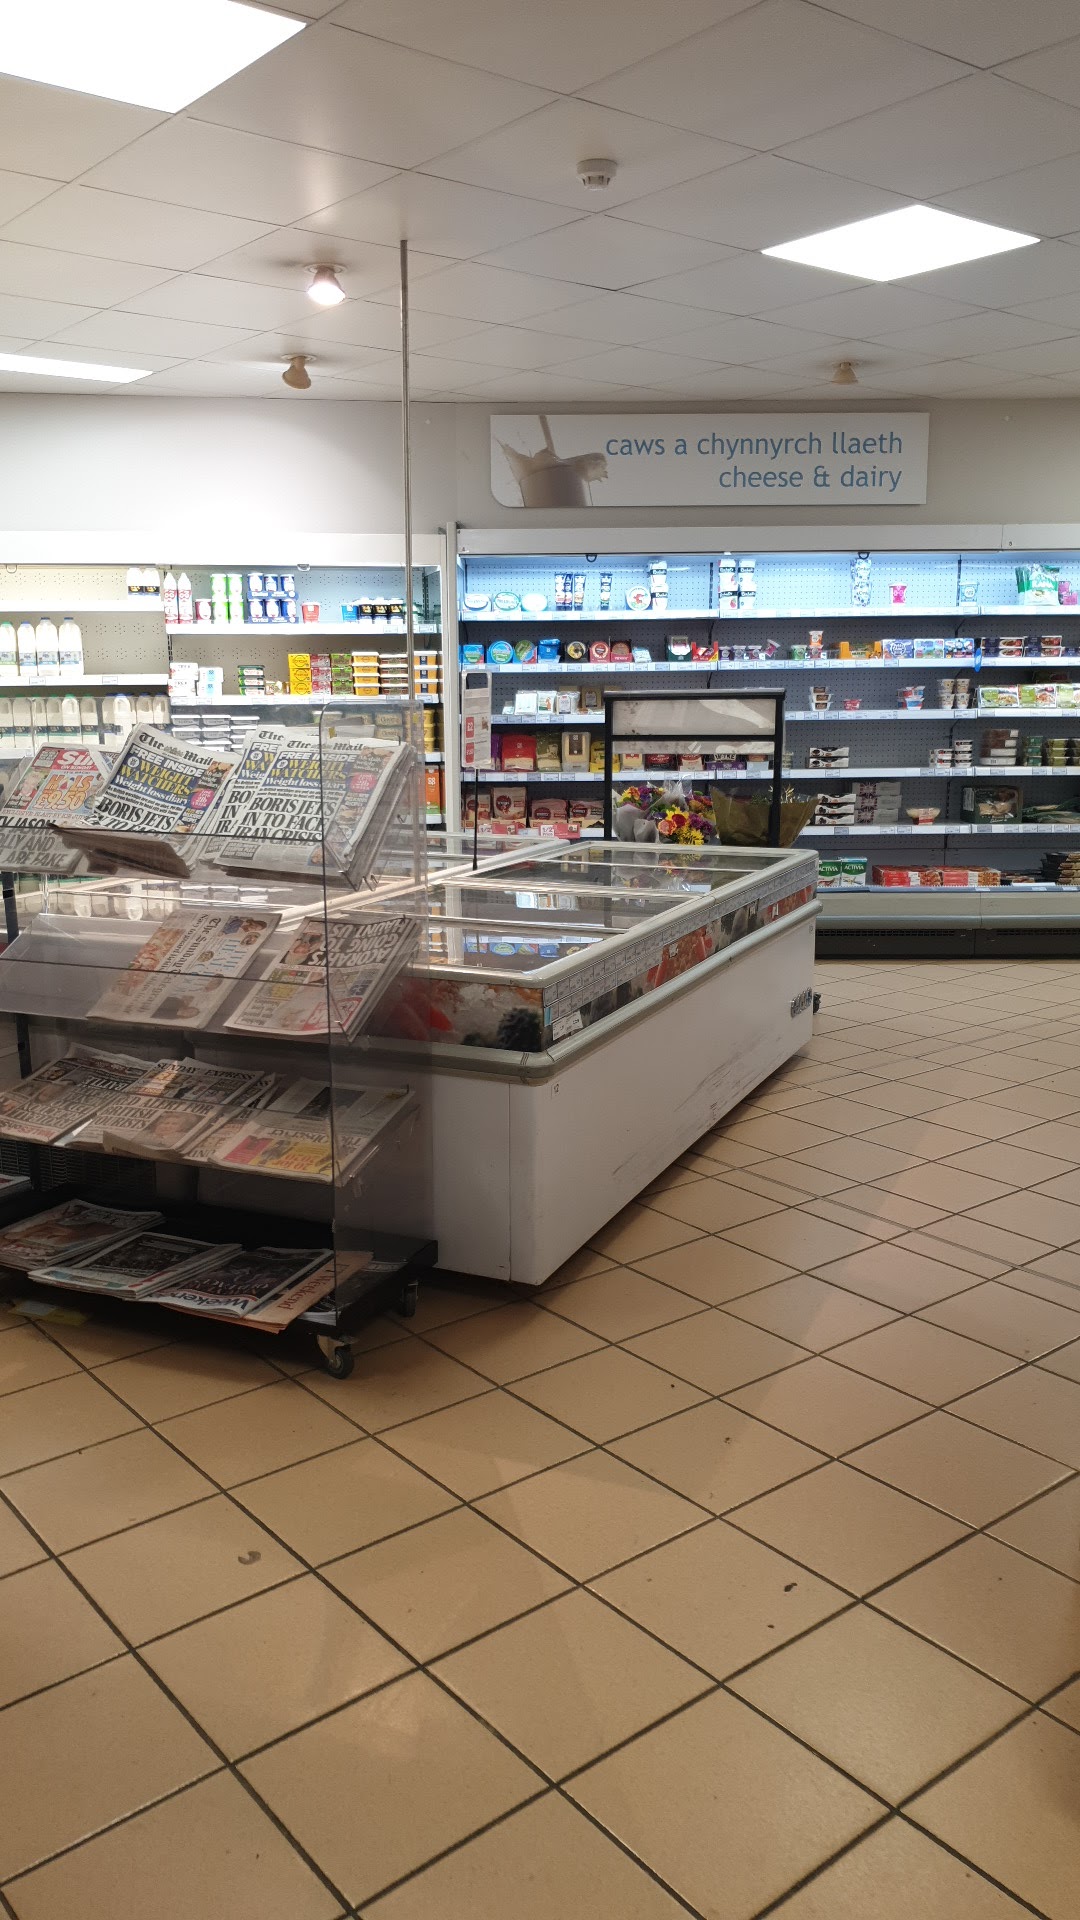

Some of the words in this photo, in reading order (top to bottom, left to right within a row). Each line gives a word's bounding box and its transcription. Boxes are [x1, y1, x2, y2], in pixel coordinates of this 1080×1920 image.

[606, 438, 665, 456] caws
[675, 438, 688, 455] a
[697, 431, 822, 460] chynnyrch
[832, 431, 903, 455] llaeth
[719, 465, 803, 488] cheese
[813, 465, 830, 488] &
[840, 464, 902, 492] dairy
[258, 730, 284, 741] The
[139, 732, 165, 750] The
[183, 751, 214, 766] Mail
[251, 742, 279, 752] FRE
[287, 740, 312, 749] The
[333, 742, 364, 751] Mail
[129, 744, 164, 765] FREE
[163, 760, 205, 778] INSIDE
[280, 751, 312, 760] FREE
[311, 752, 357, 763] INSIDE
[289, 760, 344, 771] WEIGHT
[121, 764, 193, 796] WATCHERS
[140, 760, 194, 786] WEIGHT
[265, 777, 300, 787] Weight
[299, 778, 319, 787] loss
[271, 768, 347, 779] WATCHERS
[115, 775, 148, 793] Weight
[146, 785, 165, 799] loss
[166, 793, 188, 805] diary
[32, 790, 87, 811] £9.50
[249, 797, 299, 813] BORIS
[296, 799, 338, 817] JETS
[96, 796, 145, 823] BORIS
[139, 810, 176, 831] JETS
[240, 811, 262, 826] IN
[261, 812, 286, 828] TO
[285, 814, 330, 832] FACE
[235, 825, 272, 840] IRAN
[20, 835, 56, 852] AND
[4, 850, 34, 865] ARE
[30, 852, 68, 868] FAKE
[200, 917, 222, 934] The
[328, 923, 354, 939] US
[353, 918, 405, 939] HAUNT
[170, 935, 207, 969] Sunday
[319, 937, 346, 953] TO
[346, 933, 399, 953] GOING
[308, 947, 393, 967] ACORAH'S
[156, 1063, 200, 1074] SUNDAY
[204, 1065, 256, 1080] EXPRESS
[80, 1075, 128, 1091] BATTLE
[101, 1105, 161, 1120] BRITISH
[141, 1097, 184, 1111] ALERT
[183, 1102, 216, 1116] FOR
[268, 1128, 329, 1144] Observer
[276, 1274, 332, 1310] Weekend
